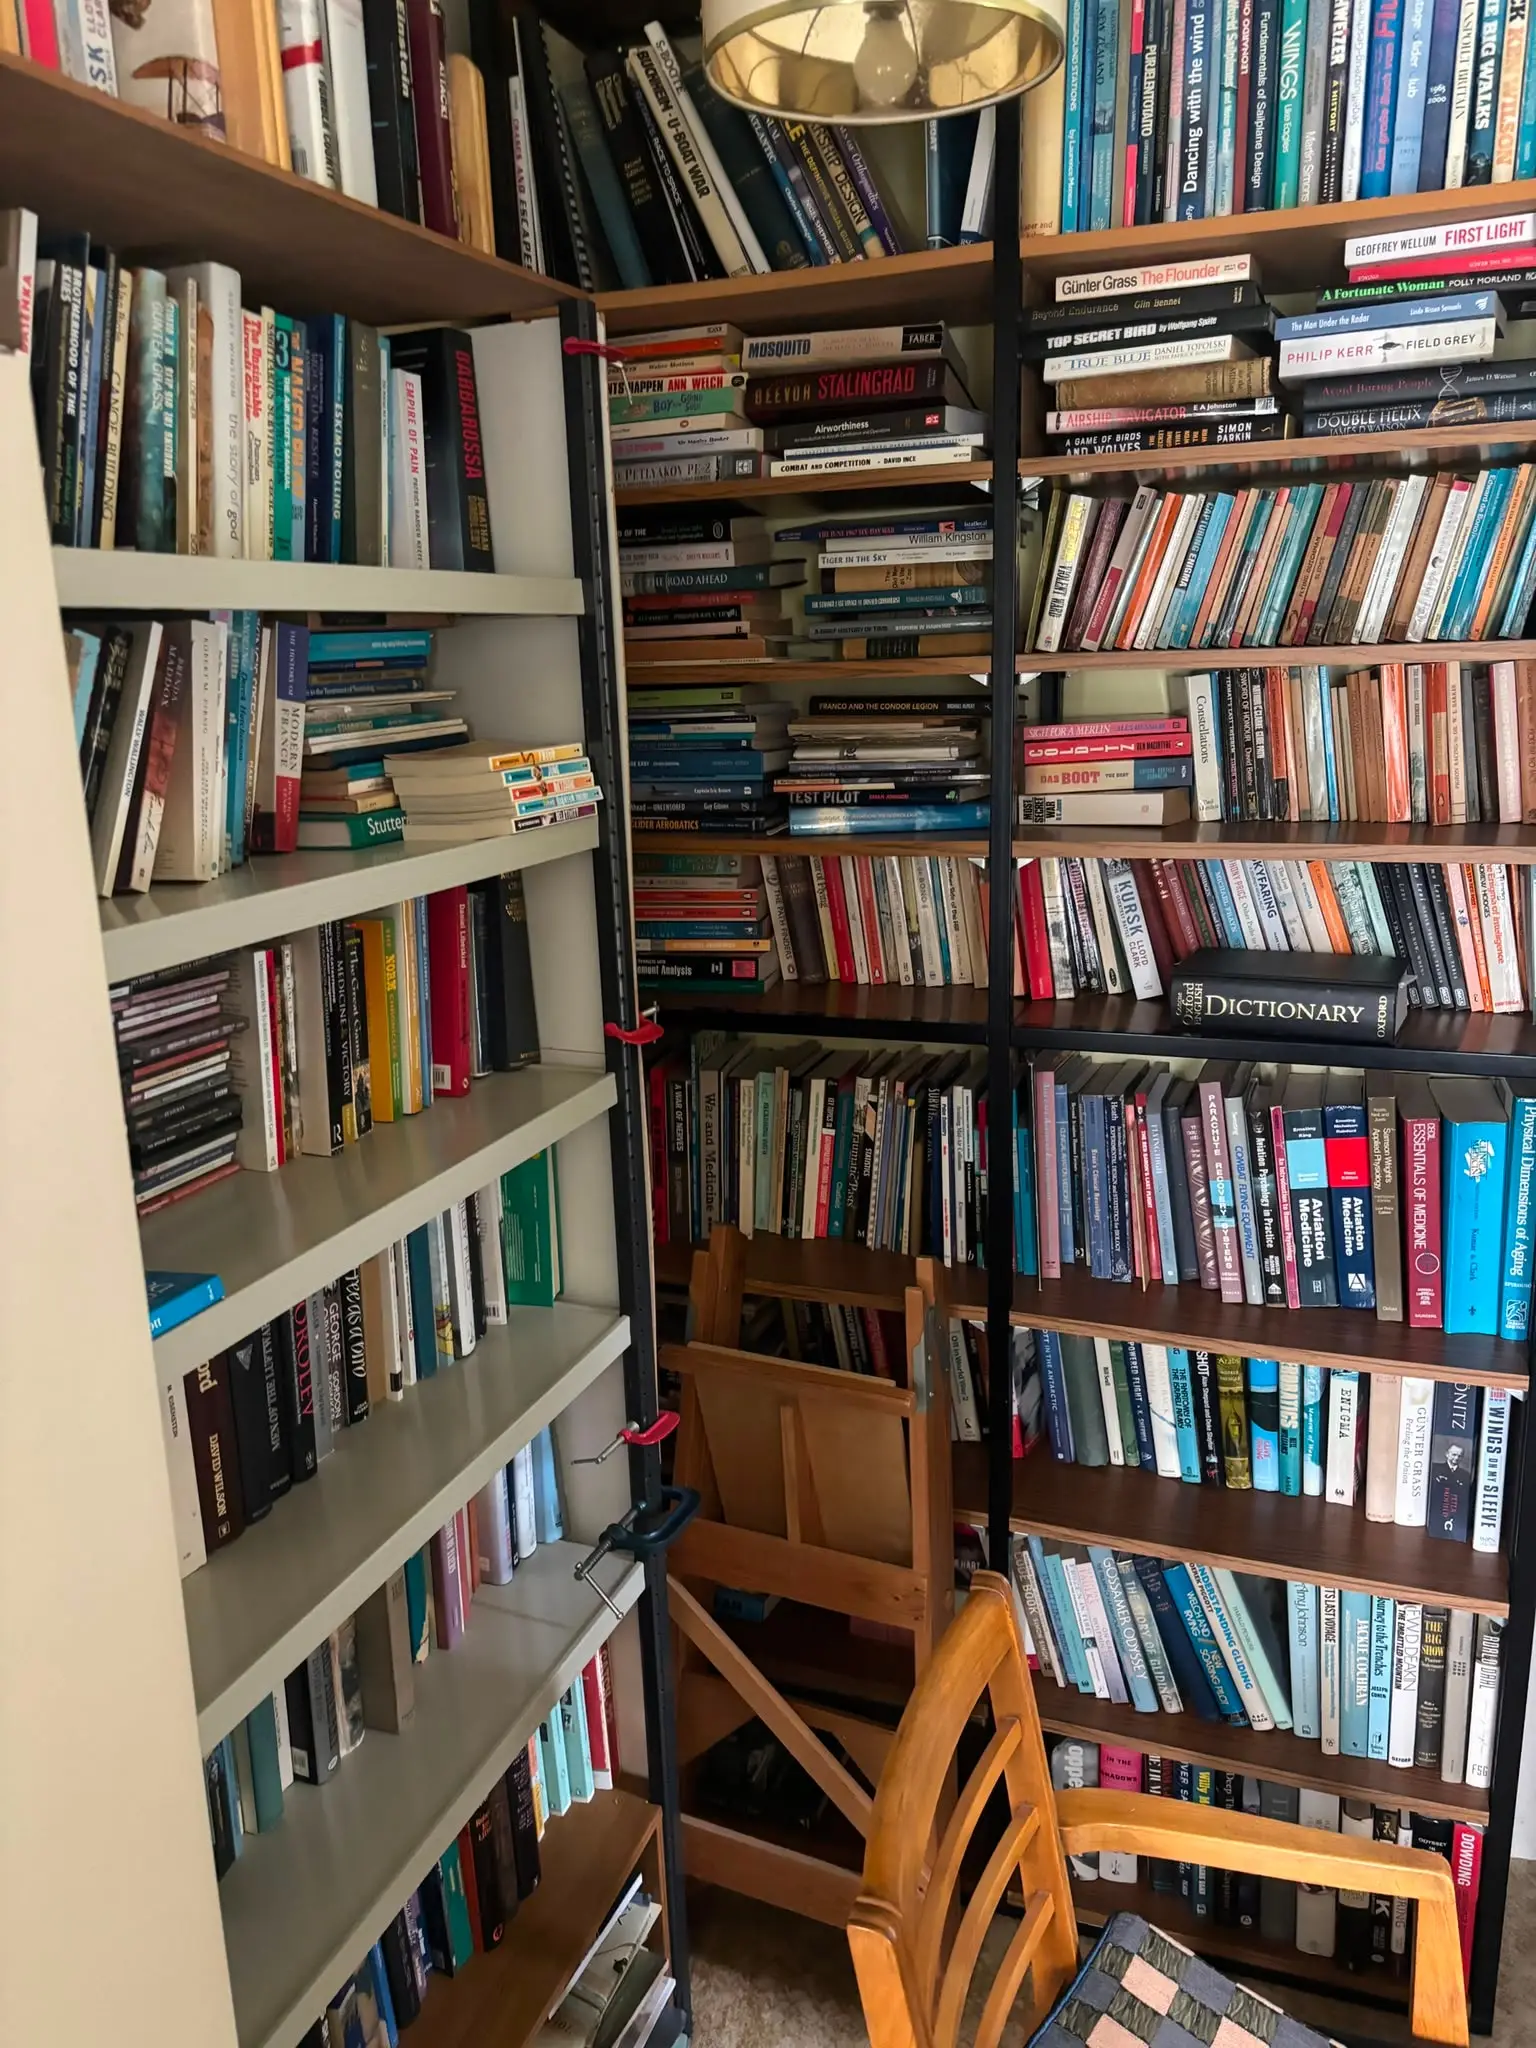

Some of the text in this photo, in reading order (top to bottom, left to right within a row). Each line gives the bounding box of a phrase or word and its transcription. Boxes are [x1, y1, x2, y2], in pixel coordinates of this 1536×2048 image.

[439, 60, 449, 119] ATTACK!
[1473, 20, 1500, 132] BIG WALKS
[1183, 13, 1205, 194] Dancing with the wind
[1250, 11, 1271, 189] Fundamentals of Sailplane Design
[688, 163, 711, 199] WAR
[1355, 220, 1527, 257] GEOFFREY WELLUM FIRST LIGHT
[60, 264, 72, 303] SKIES
[1061, 263, 1221, 296] Günter Grass The Flounder
[1322, 273, 1522, 301] A Fortunate Woman POLLY MORLAND
[66, 266, 82, 417] BROTHERHOOD OF THE
[747, 337, 812, 359] MOSQUITO
[908, 333, 936, 346] FABER
[1286, 334, 1477, 364] PHILIP KERR FIELD GREY
[250, 347, 262, 418] Unsinkable
[816, 367, 917, 401] STALINGRAD
[405, 380, 418, 426] EMPIRE
[1316, 408, 1422, 430] DOUBLE HELIX
[229, 413, 239, 440] the
[408, 430, 418, 445] OF
[814, 419, 870, 435] Airworthiness
[1065, 431, 1142, 447] A GAME OF BIRDS
[1216, 431, 1252, 443] PARKIN
[1217, 422, 1253, 434] SIMON
[226, 444, 240, 485] story
[332, 401, 344, 520] ESKIMO ROLLING
[410, 447, 420, 475] PAIN
[780, 462, 809, 473] COMBAT
[809, 463, 824, 471] AND
[823, 458, 872, 471] COMPETITION
[883, 456, 902, 466] DAVID
[230, 490, 239, 506] of
[226, 508, 240, 542] god
[908, 532, 987, 545] William Kingston
[820, 555, 844, 566] TIGER
[844, 555, 855, 564] IN
[855, 554, 871, 563] THE
[160, 644, 178, 709] MADDOX
[170, 657, 186, 704] BRENDA
[288, 647, 297, 684] HISTORY
[818, 702, 940, 711] FRANCO AND THE CONDOR LEGION
[1195, 694, 1209, 755] Constellations
[124, 709, 146, 798] WALLY WALLINGTON
[281, 707, 290, 769] FRANCE
[289, 705, 301, 772] MODERN
[655, 819, 700, 831] AEROBATICS
[1022, 797, 1033, 821] MOST
[1034, 796, 1045, 824] SECRET
[1045, 801, 1056, 821] WAR
[1118, 879, 1144, 937] KURSK
[1170, 877, 1186, 916] LONGITUDE
[1214, 870, 1238, 933] MICHAEL FRAYN
[774, 888, 793, 961] THE PATH FINDERS
[1128, 940, 1141, 969] CLARK
[1135, 939, 1149, 967] LLOYD
[336, 959, 352, 1097] MEDICINE VICTORY
[1204, 993, 1389, 1039] DICTIONARY OXFORD
[674, 1090, 683, 1112] WAR
[675, 1111, 683, 1123] OF
[703, 1092, 718, 1213] War and Medicine
[1255, 1136, 1274, 1249] Aviation Psychology in Practice
[1412, 1123, 1427, 1250] ESSENTIALS OF MEDICINE
[1297, 1198, 1313, 1269] Medicine
[1310, 1197, 1326, 1261] Aviation
[1341, 1197, 1354, 1257] Medicine
[1351, 1196, 1365, 1251] Aviation
[329, 1301, 342, 1420] GEORGE GORDON
[1338, 1388, 1352, 1439] ENIGMA
[209, 1432, 227, 1518] DAVID WILSON
[1022, 1582, 1038, 1615] BOOK
[1324, 1602, 1337, 1622] LAST
[1103, 1556, 1130, 1625] GOSSAMER
[1123, 1625, 1149, 1680] ODYSSEY
[1324, 1619, 1337, 1644] VOYAGE
[1424, 1620, 1443, 1633] THE
[1421, 1646, 1445, 1658] SHOW
[1424, 1634, 1442, 1645] BIG
[1418, 1836, 1448, 1847] ODYSSEY
[1457, 1832, 1476, 1888] DOWDING
